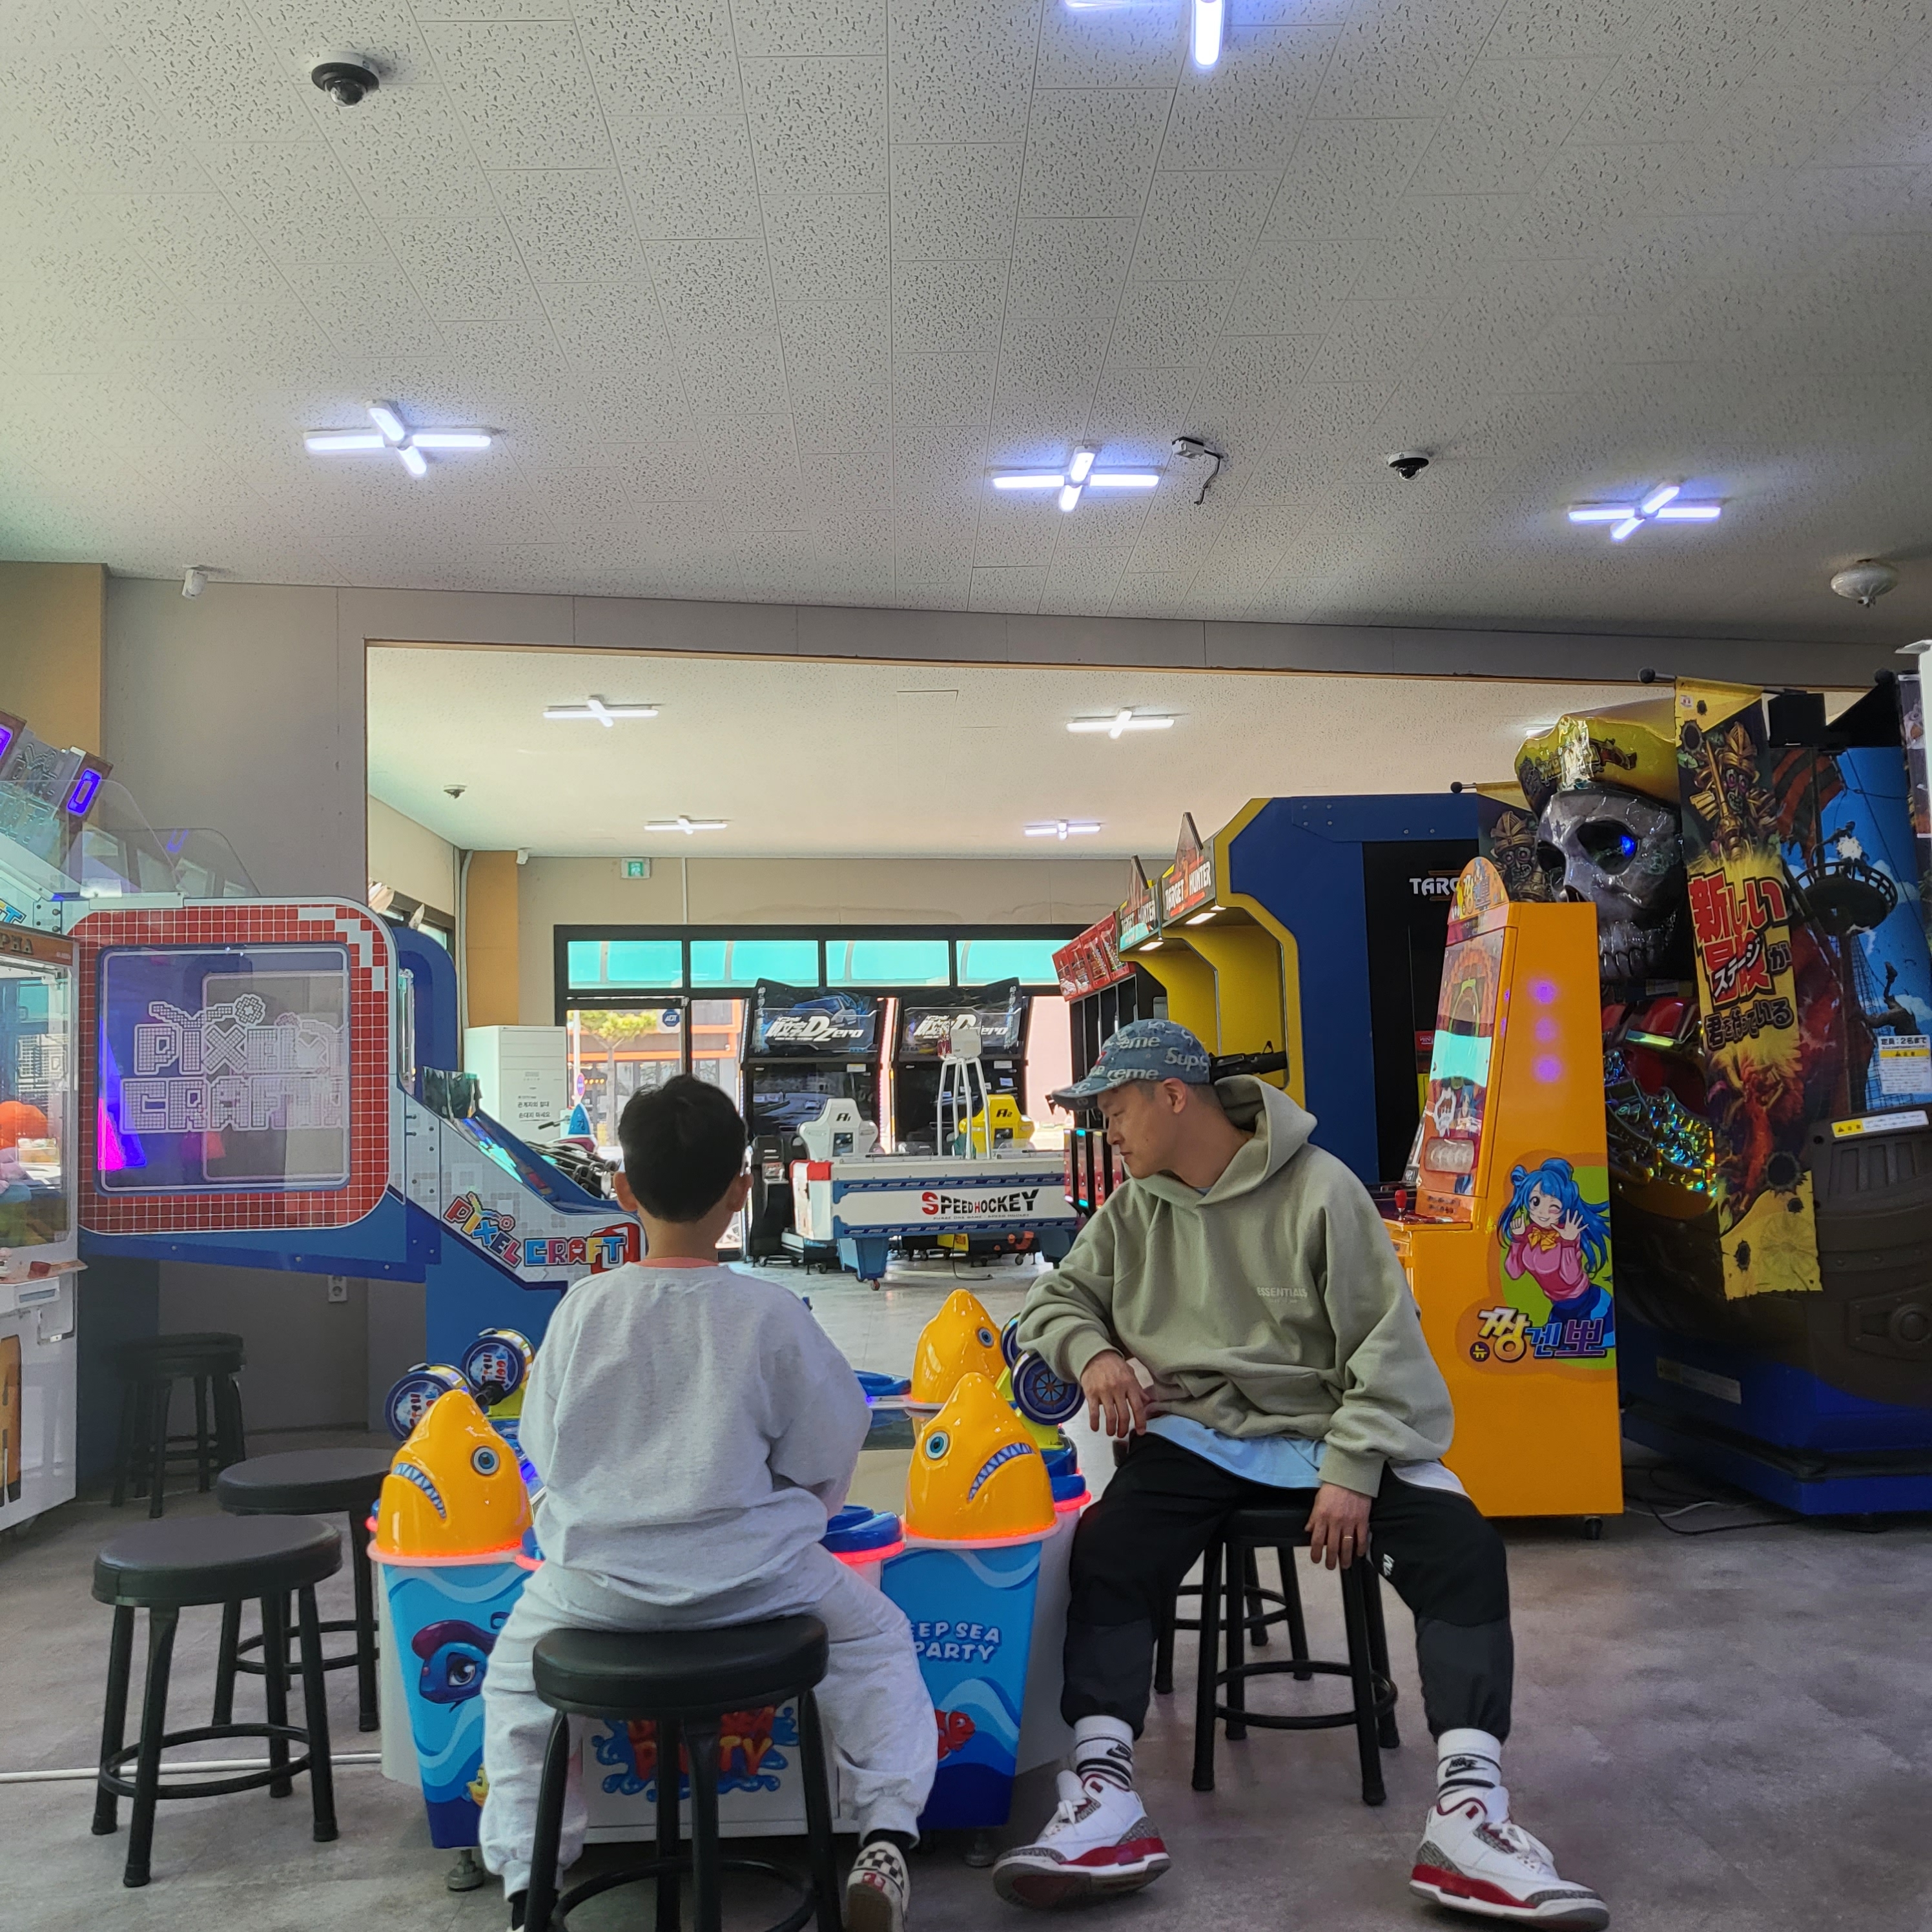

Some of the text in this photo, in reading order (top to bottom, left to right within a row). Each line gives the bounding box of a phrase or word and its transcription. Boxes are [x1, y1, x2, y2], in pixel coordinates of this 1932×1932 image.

[1165, 861, 1211, 910] TARGET HUNTER
[1688, 872, 1787, 944] 新しい
[1714, 937, 1761, 998] ステージ
[813, 1027, 865, 1042] Zero
[970, 1026, 1009, 1036] ero
[444, 1195, 522, 1268] PIXEL
[524, 1237, 627, 1266] CRAFT
[1472, 1344, 1488, 1359] 뉴
[910, 1621, 1000, 1643] EP SEA
[914, 1640, 995, 1661] PARTY
